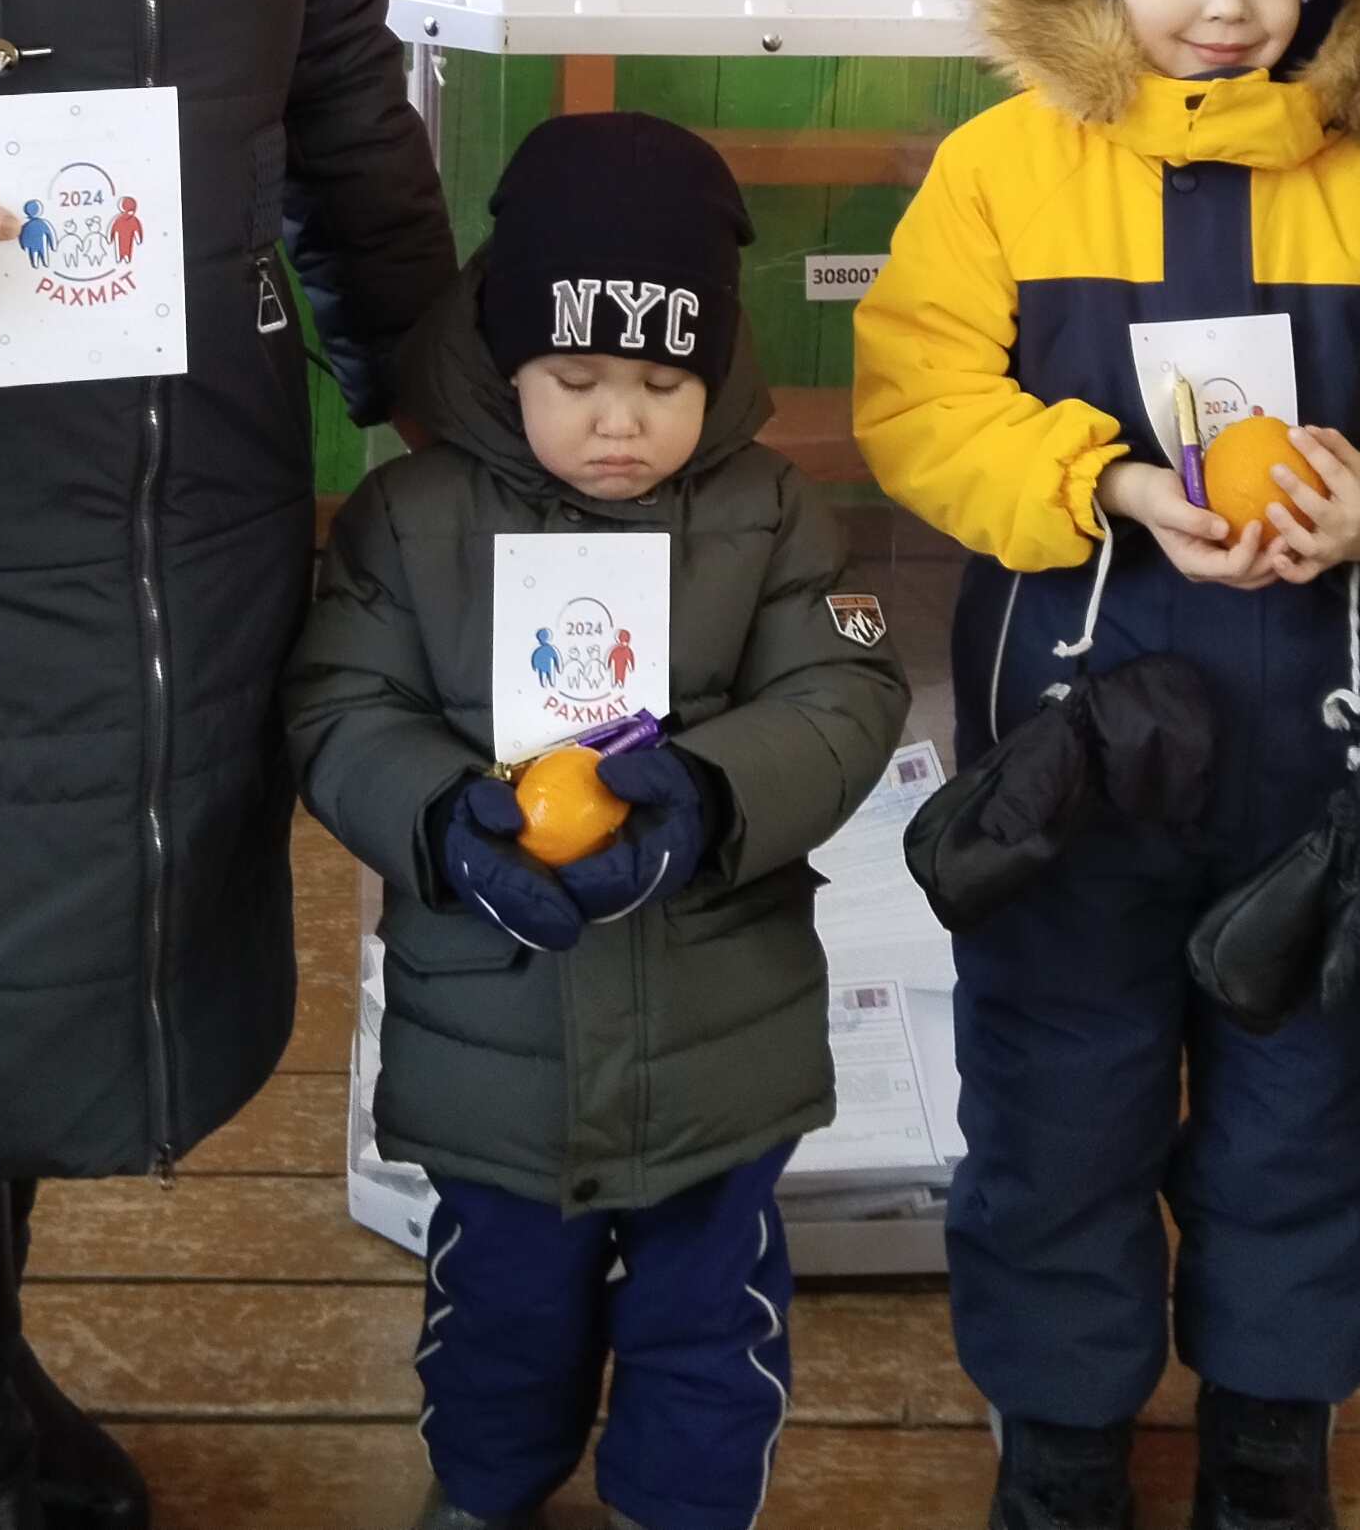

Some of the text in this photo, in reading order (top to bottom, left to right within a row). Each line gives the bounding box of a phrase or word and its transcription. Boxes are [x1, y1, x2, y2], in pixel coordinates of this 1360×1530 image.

[59, 189, 104, 208] 2024
[35, 271, 137, 307] РАХМАТ
[551, 278, 700, 356] NYC
[1203, 400, 1238, 415] 2024
[565, 621, 604, 637] 2024
[543, 695, 629, 724] РАХМАТ
